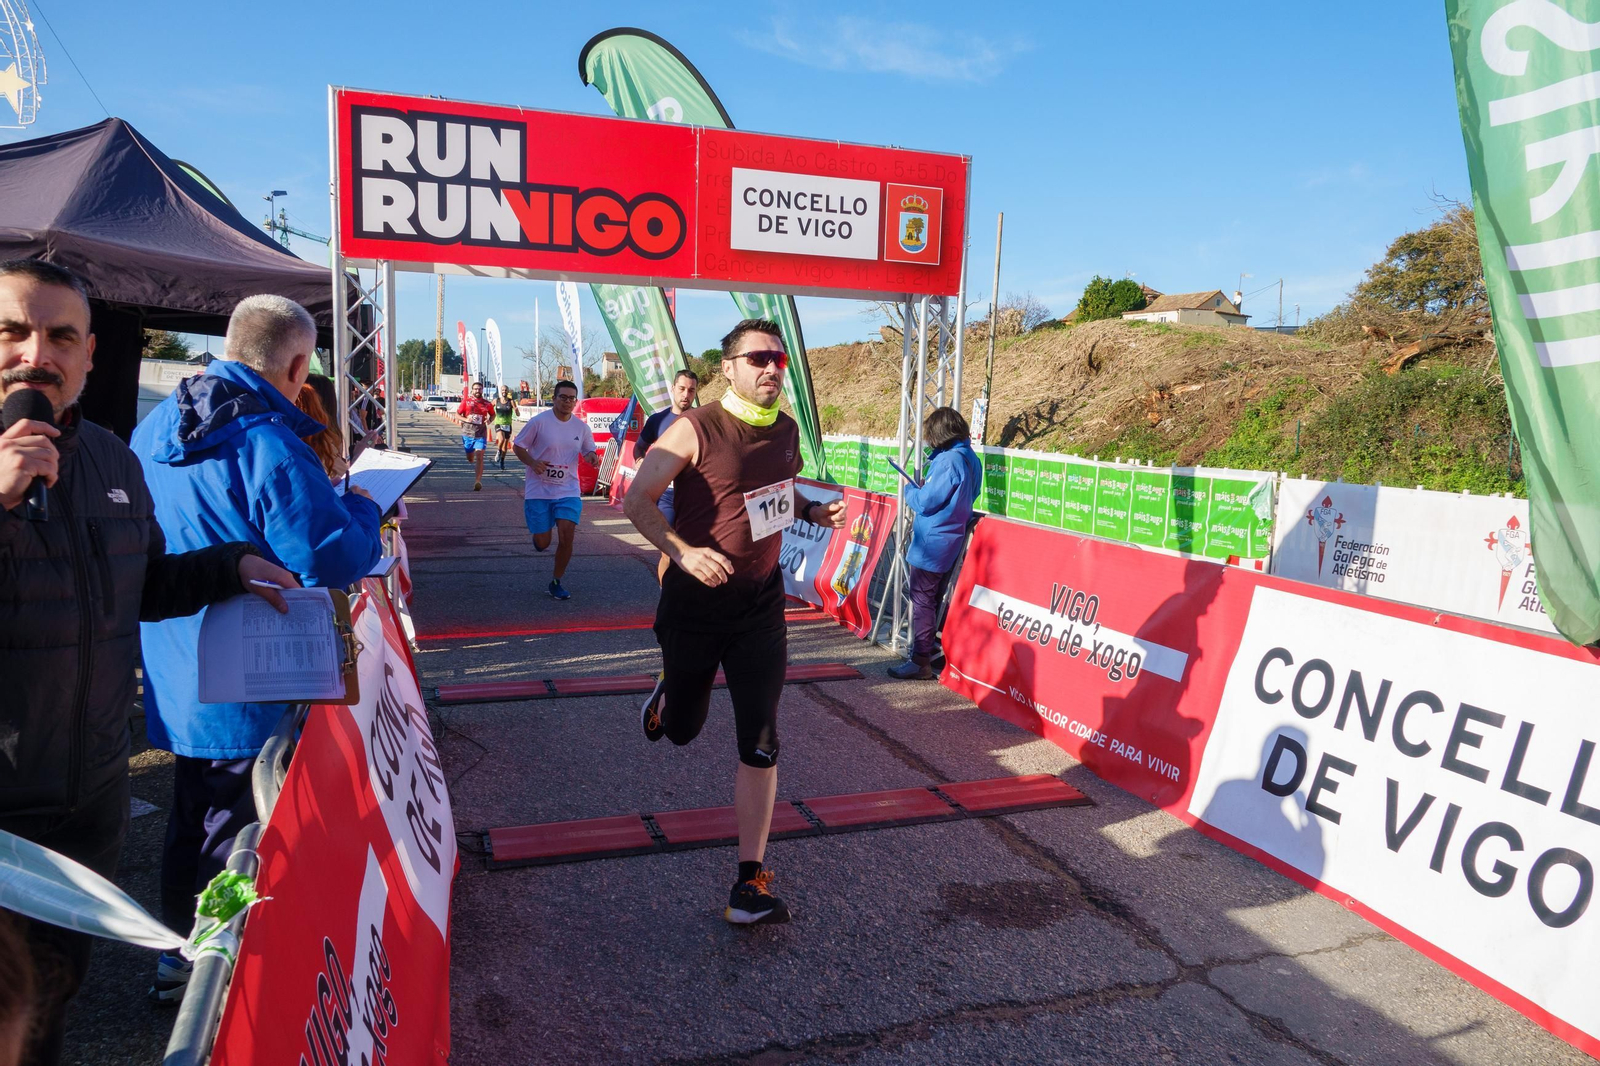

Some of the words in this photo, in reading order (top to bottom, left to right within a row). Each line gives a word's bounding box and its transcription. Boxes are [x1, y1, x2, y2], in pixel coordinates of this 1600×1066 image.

[360, 113, 522, 182] RUN
[706, 140, 775, 167] Subida
[783, 151, 808, 169] Ao
[814, 152, 877, 176] Castro
[742, 187, 868, 216] CONCELLO
[758, 214, 788, 234] DE
[798, 217, 853, 240] VIGO
[704, 252, 774, 275] Cáncer
[792, 260, 834, 283] Vigo
[546, 469, 565, 479] 120
[759, 493, 790, 521] 116
[1320, 508, 1331, 516] FGA
[1334, 535, 1390, 556] Federación
[1505, 530, 1520, 539] FGA
[1332, 563, 1385, 583] Atletismo
[1333, 550, 1375, 569] Galega
[1376, 559, 1388, 570] de
[996, 602, 1051, 646] terreo
[1057, 624, 1083, 658] de
[1085, 637, 1142, 682] xogo
[1069, 720, 1108, 748] CIDADE
[1109, 738, 1142, 765] PARA
[1148, 754, 1180, 782] VIVIR
[1261, 733, 1357, 826] DE
[1384, 776, 1594, 929] VIGO
